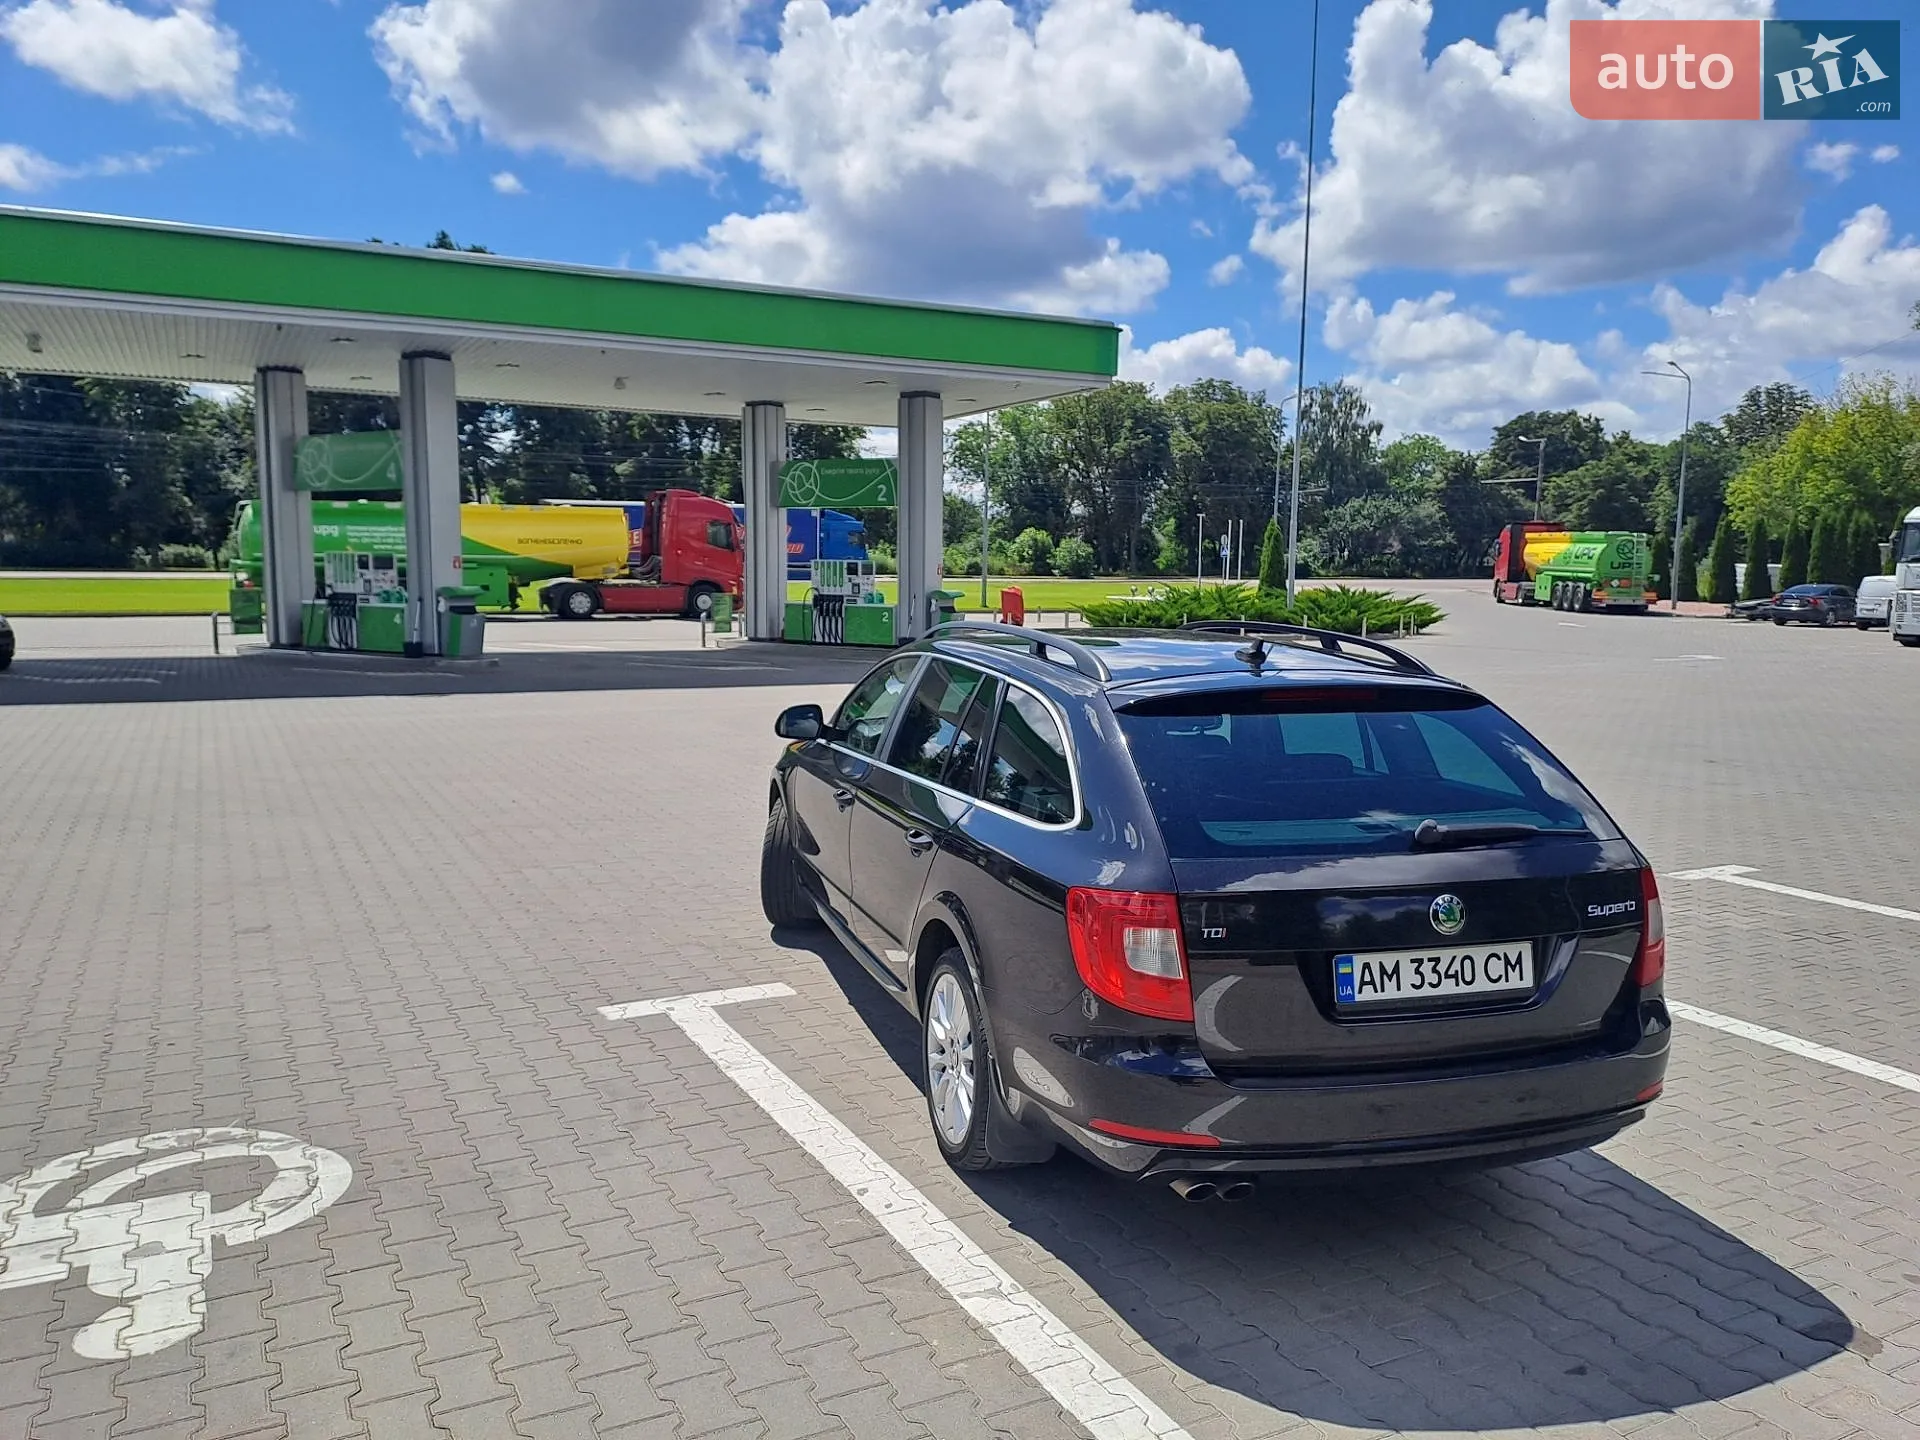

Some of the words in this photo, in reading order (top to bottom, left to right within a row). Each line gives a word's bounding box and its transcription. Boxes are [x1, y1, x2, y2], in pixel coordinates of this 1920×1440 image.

[386, 461, 397, 482] 4
[877, 484, 888, 502] 2
[1574, 546, 1598, 559] UPG
[394, 613, 402, 625] 4
[882, 611, 890, 622] 2
[1587, 900, 1636, 917] Superb
[1201, 927, 1227, 939] TDI
[1339, 986, 1354, 996] UA
[1357, 960, 1401, 994] AM
[1409, 954, 1476, 990] 3340
[1483, 950, 1524, 983] CM
